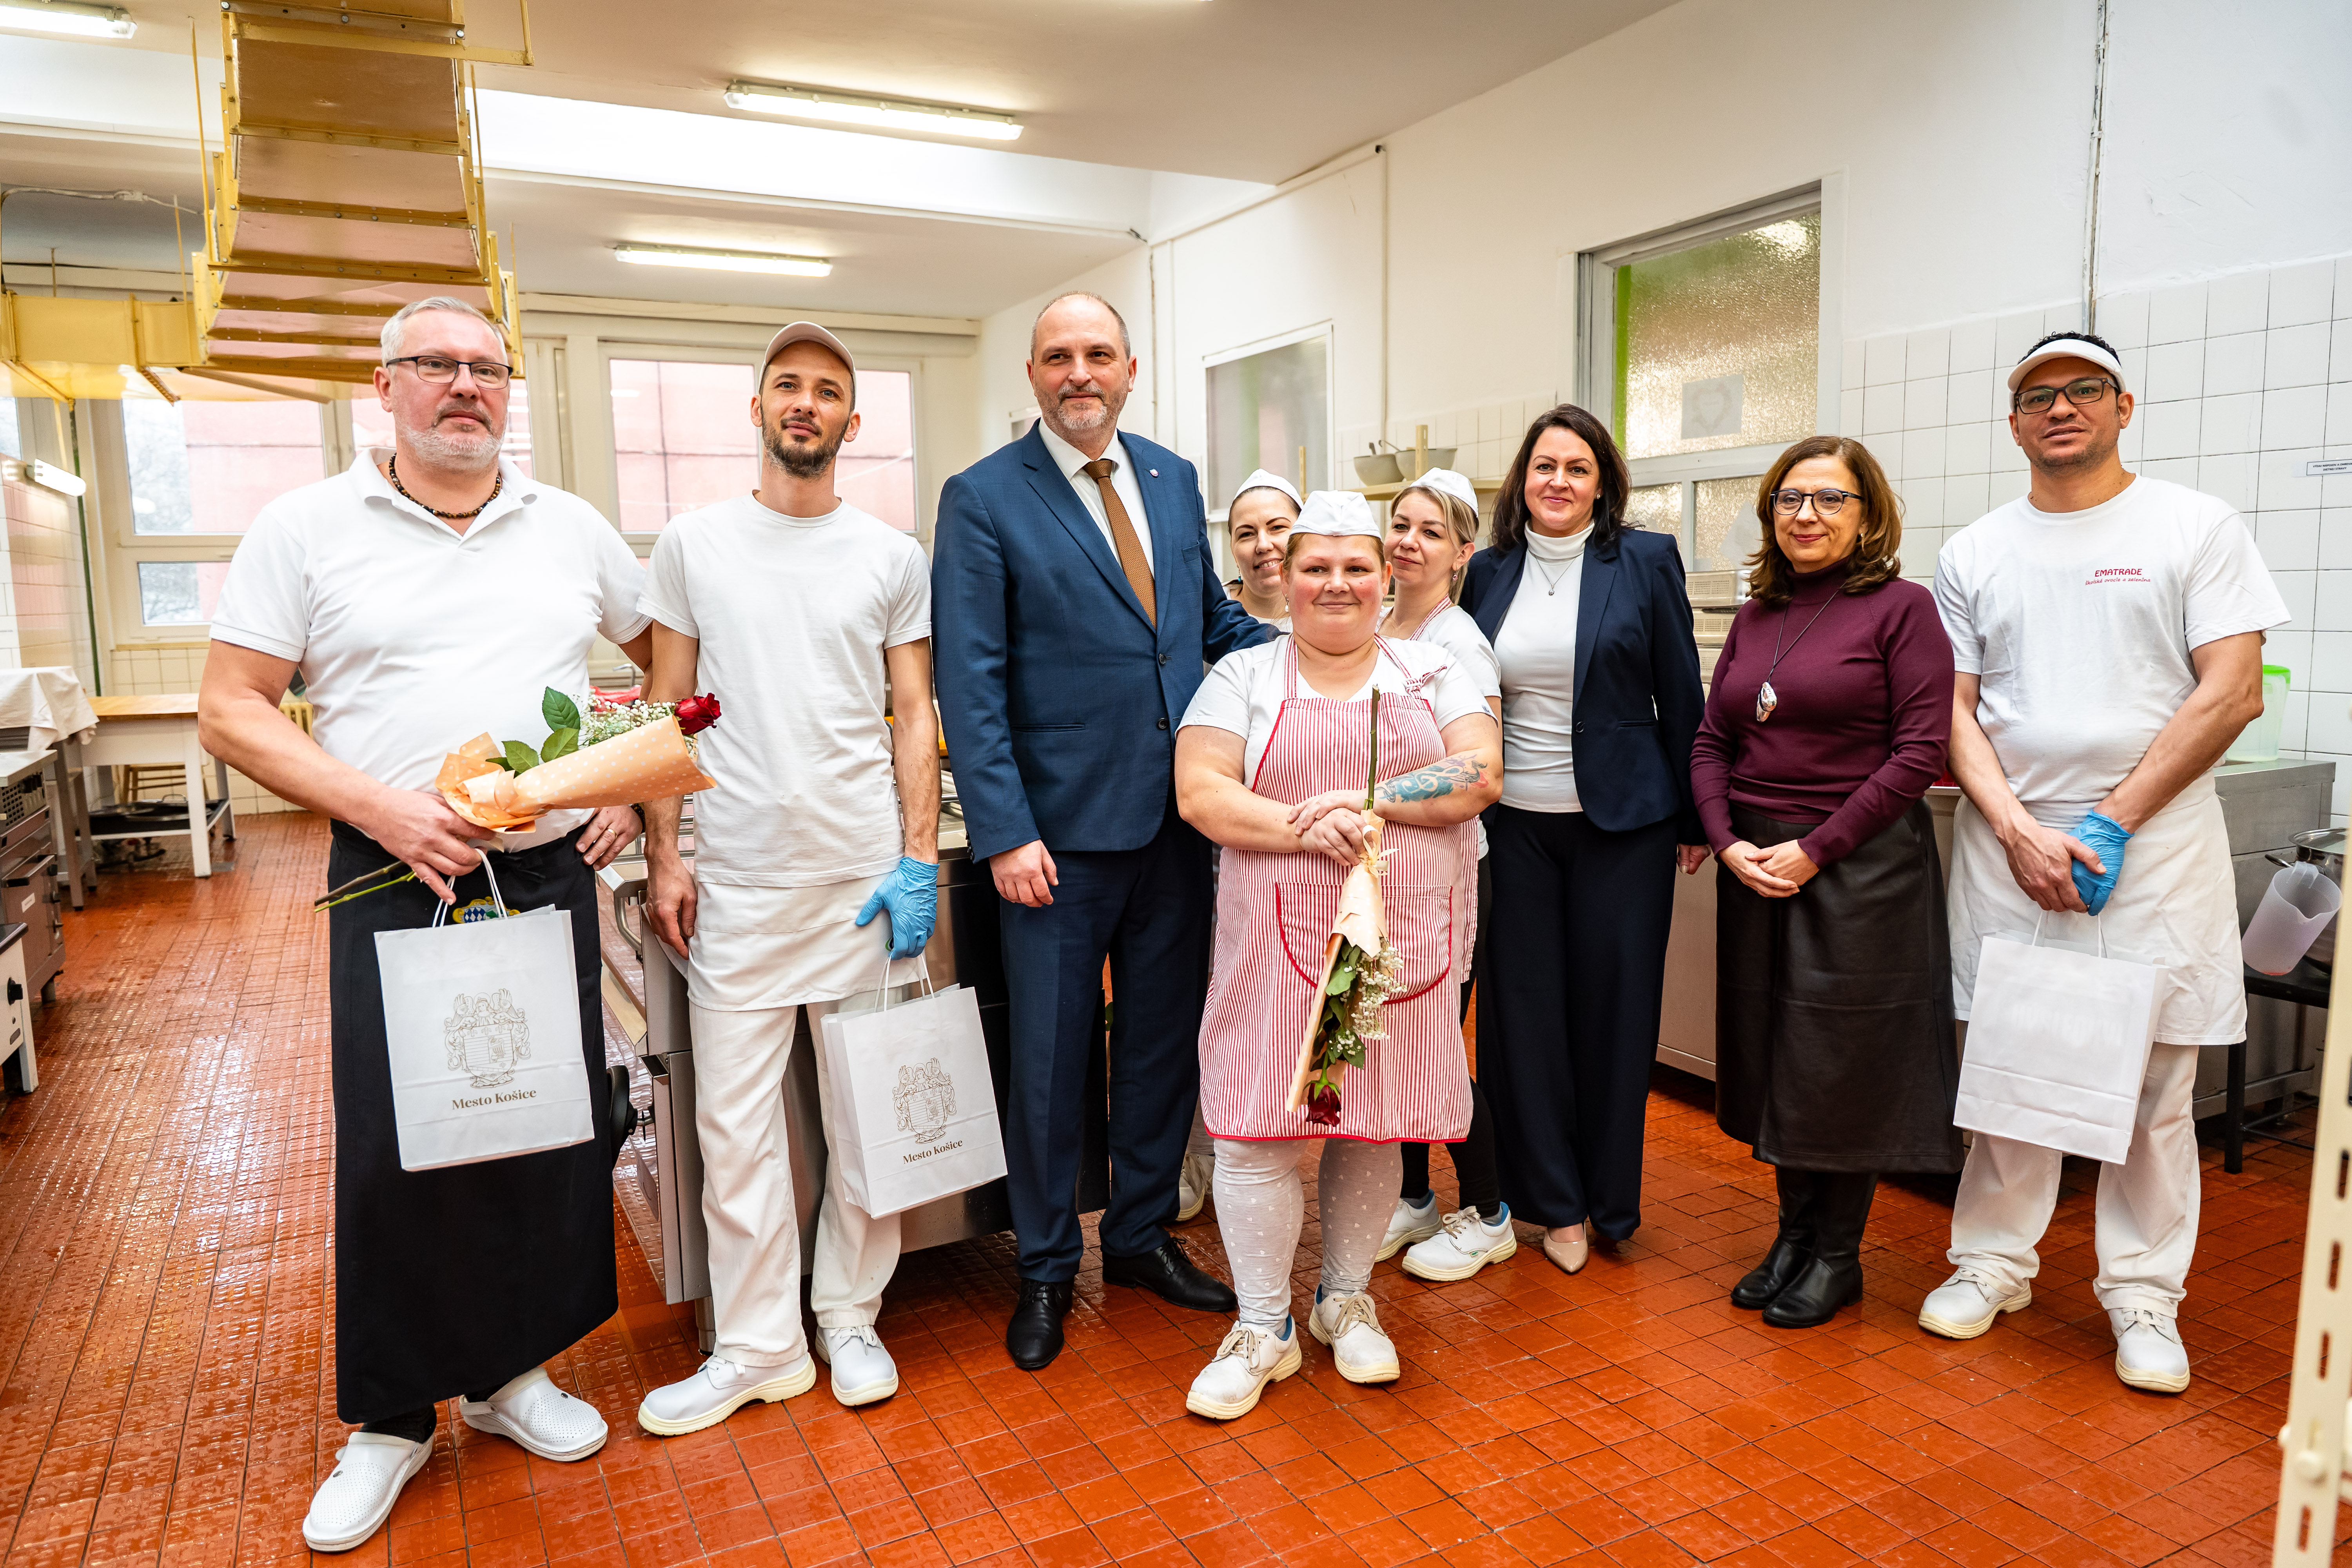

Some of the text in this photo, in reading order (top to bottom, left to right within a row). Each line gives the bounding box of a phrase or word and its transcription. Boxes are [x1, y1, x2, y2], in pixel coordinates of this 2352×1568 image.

[2094, 568, 2142, 577] EMATRADE
[452, 1089, 537, 1110] Mesto Košice
[903, 1140, 963, 1164] Mesto Košice
